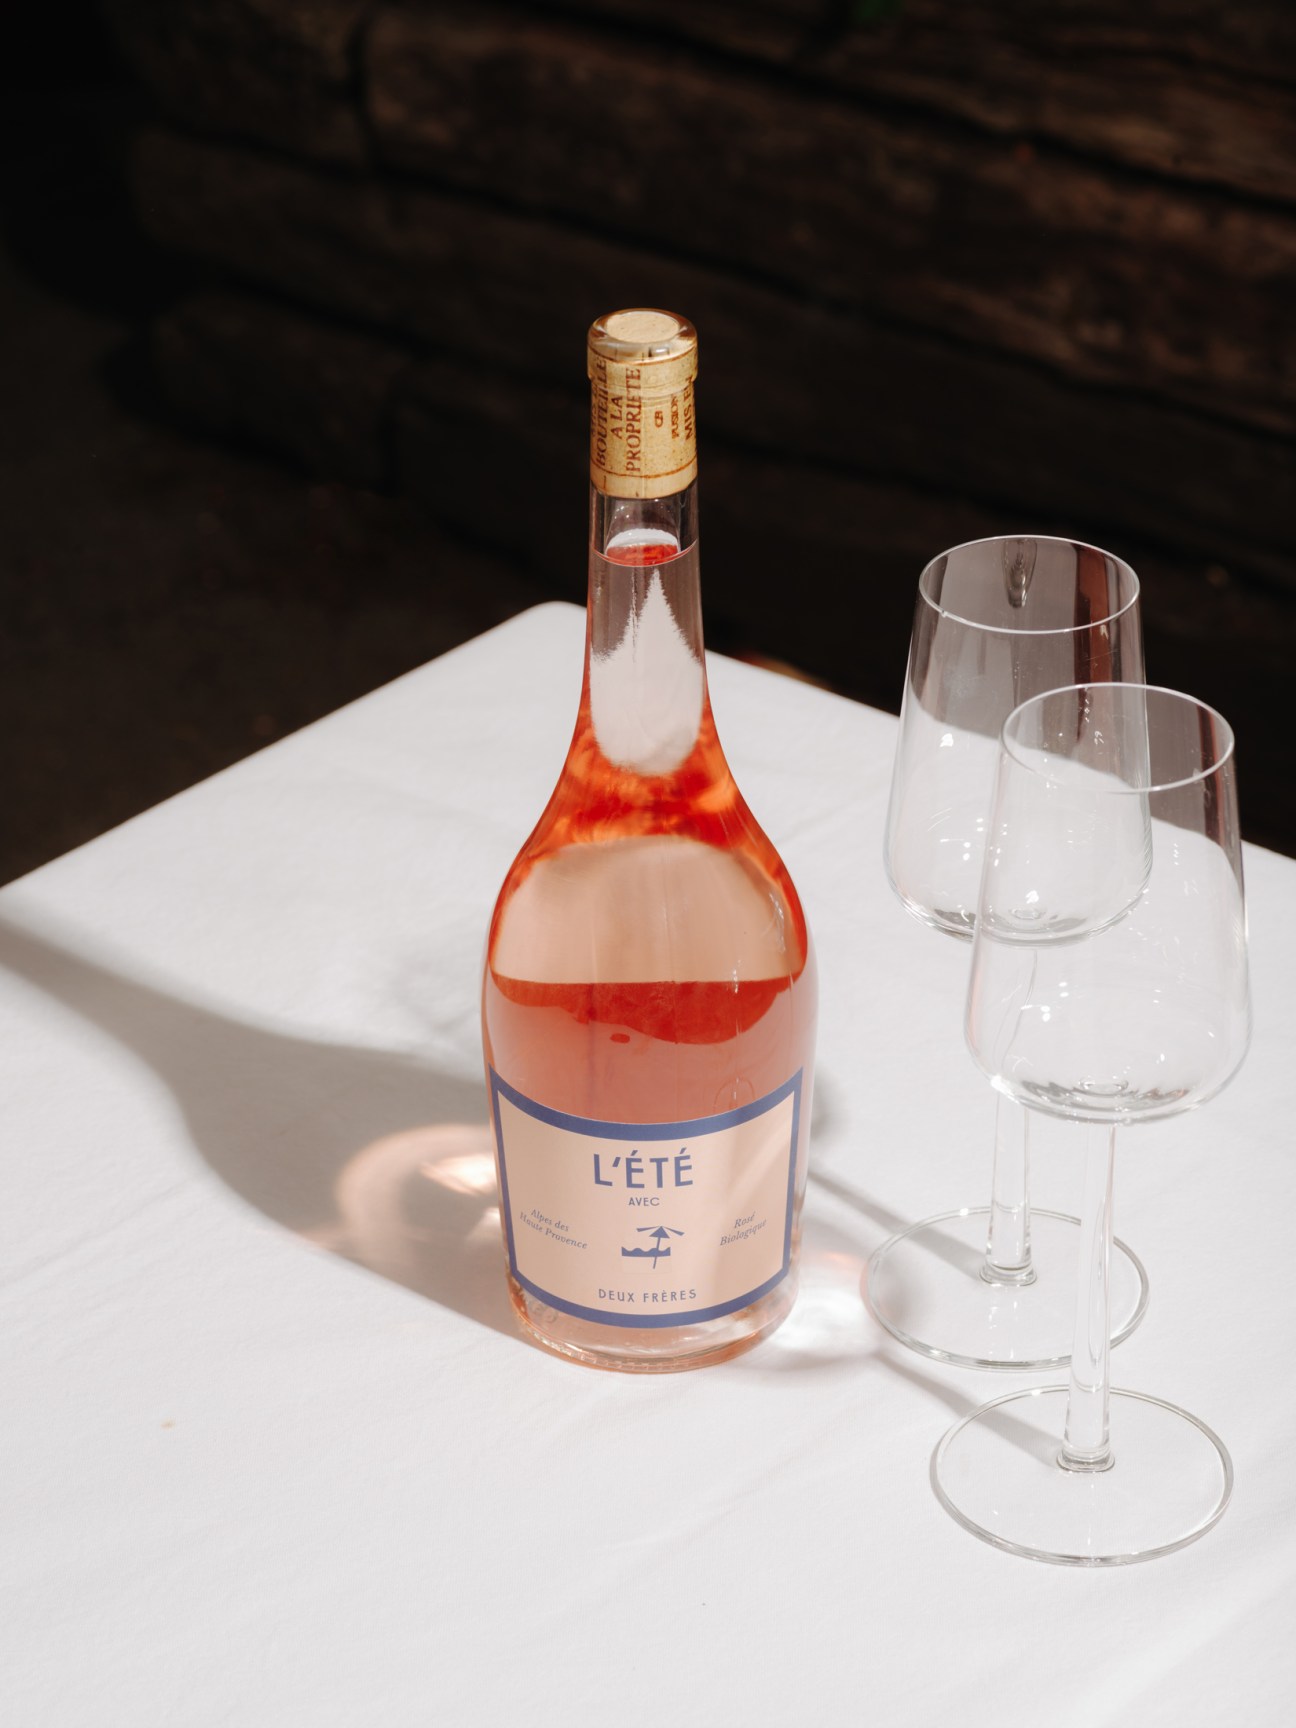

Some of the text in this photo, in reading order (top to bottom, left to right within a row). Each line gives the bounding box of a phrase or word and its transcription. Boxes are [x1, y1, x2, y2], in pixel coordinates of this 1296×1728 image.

[610, 395, 623, 439] A LA
[626, 367, 641, 472] PROPRIETE
[684, 406, 694, 440] MIS
[593, 1147, 694, 1189] L'ÉTÉ
[628, 1197, 661, 1207] AVEC
[520, 1212, 588, 1250] Haute Provence
[530, 1209, 570, 1232] Alpes des
[720, 1218, 767, 1246] Biologique
[734, 1210, 756, 1229] Rosé
[598, 1288, 697, 1303] DEUX FRÈRES
